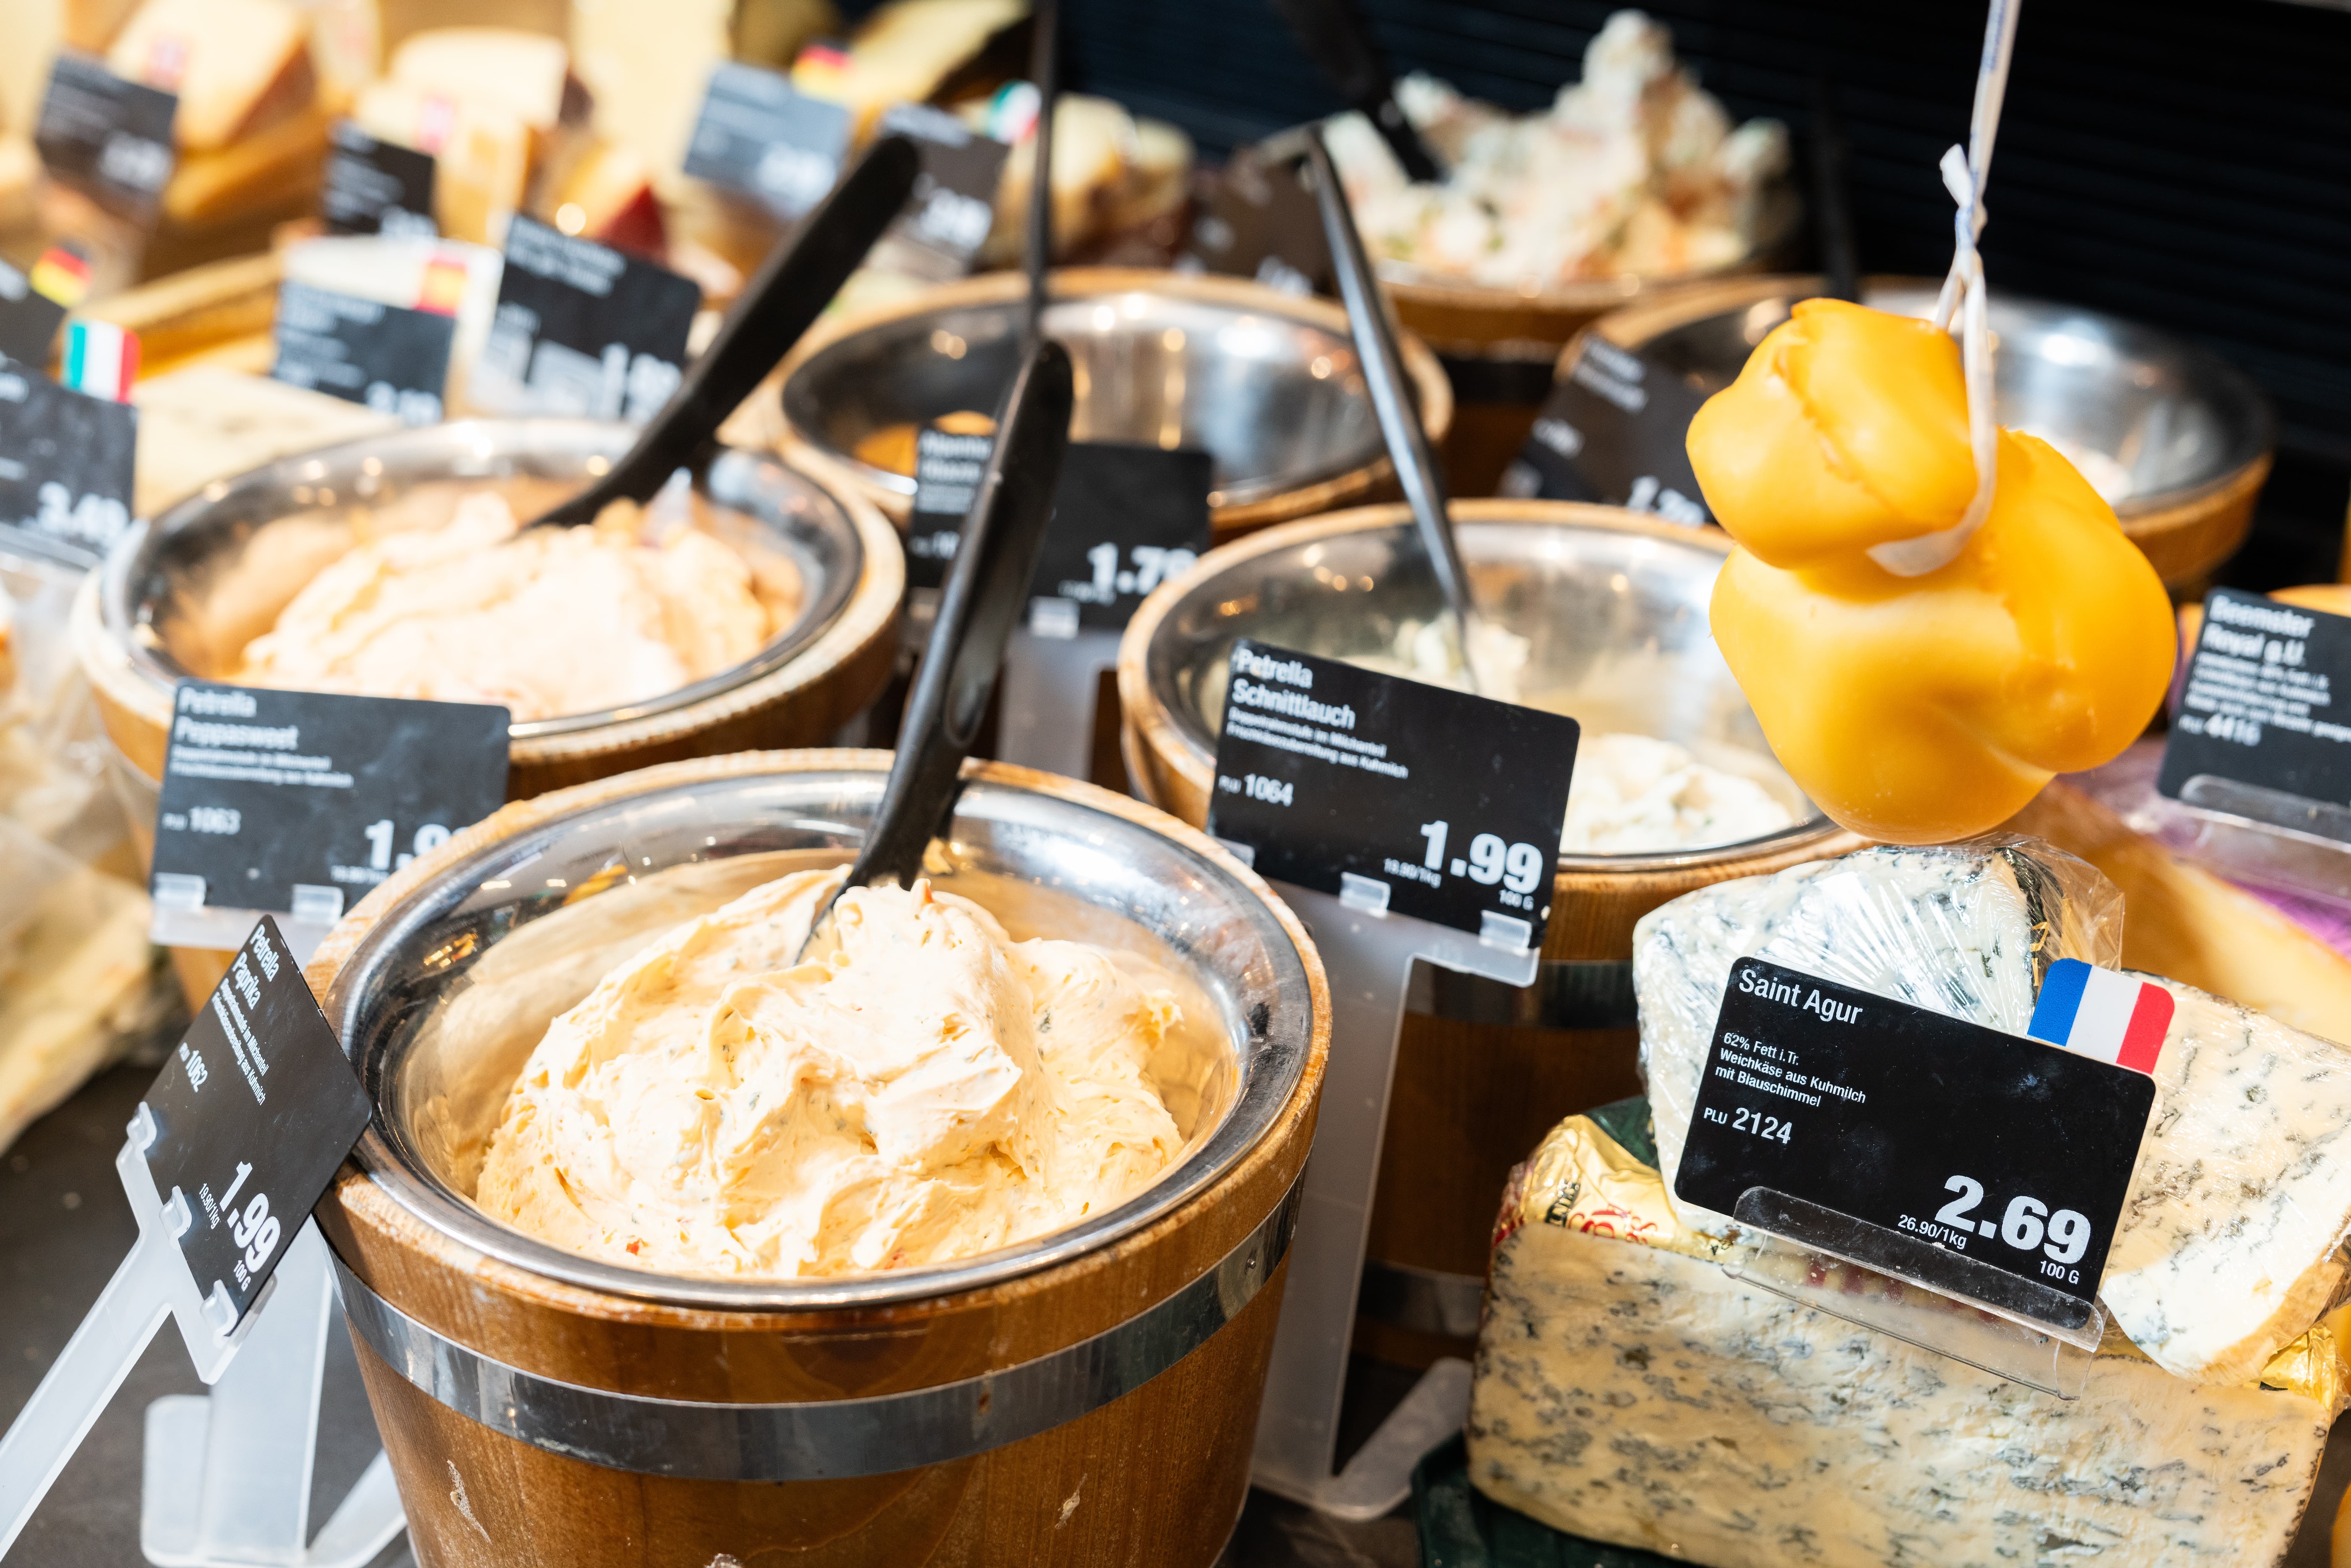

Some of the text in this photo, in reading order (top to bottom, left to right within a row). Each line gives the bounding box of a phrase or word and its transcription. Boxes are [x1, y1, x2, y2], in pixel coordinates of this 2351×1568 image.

[1236, 647, 1313, 689] Petrella
[1232, 678, 1356, 730] Schnittlauch
[1244, 773, 1294, 807] 1064
[364, 819, 469, 870] 1.9
[1420, 820, 1543, 894] 1.99
[1499, 889, 1534, 911] 100 G
[250, 924, 279, 982] Petrella
[232, 952, 260, 1010] Paprika
[1739, 969, 1863, 1024] Saint Agur
[247, 1035, 269, 1076] Milchanteil
[1724, 1032, 1749, 1050] 62%
[1753, 1041, 1777, 1059] Fett
[185, 1050, 207, 1093] 1062
[241, 1059, 251, 1075] aus
[247, 1069, 266, 1105] Kuhmilch
[1715, 1066, 1821, 1106] mit Blauschimmel
[1720, 1048, 1866, 1103] Weichkäse aus Kuhmilch
[1704, 1107, 1792, 1144] PLU 2124
[199, 1183, 220, 1229] 19.90/1kg
[220, 1161, 280, 1273] 1.99
[1934, 1175, 2091, 1264] 2.69
[1898, 1214, 1967, 1250] 26.90/1kg
[234, 1260, 251, 1292] 100 G
[2041, 1261, 2080, 1284] 100 G
